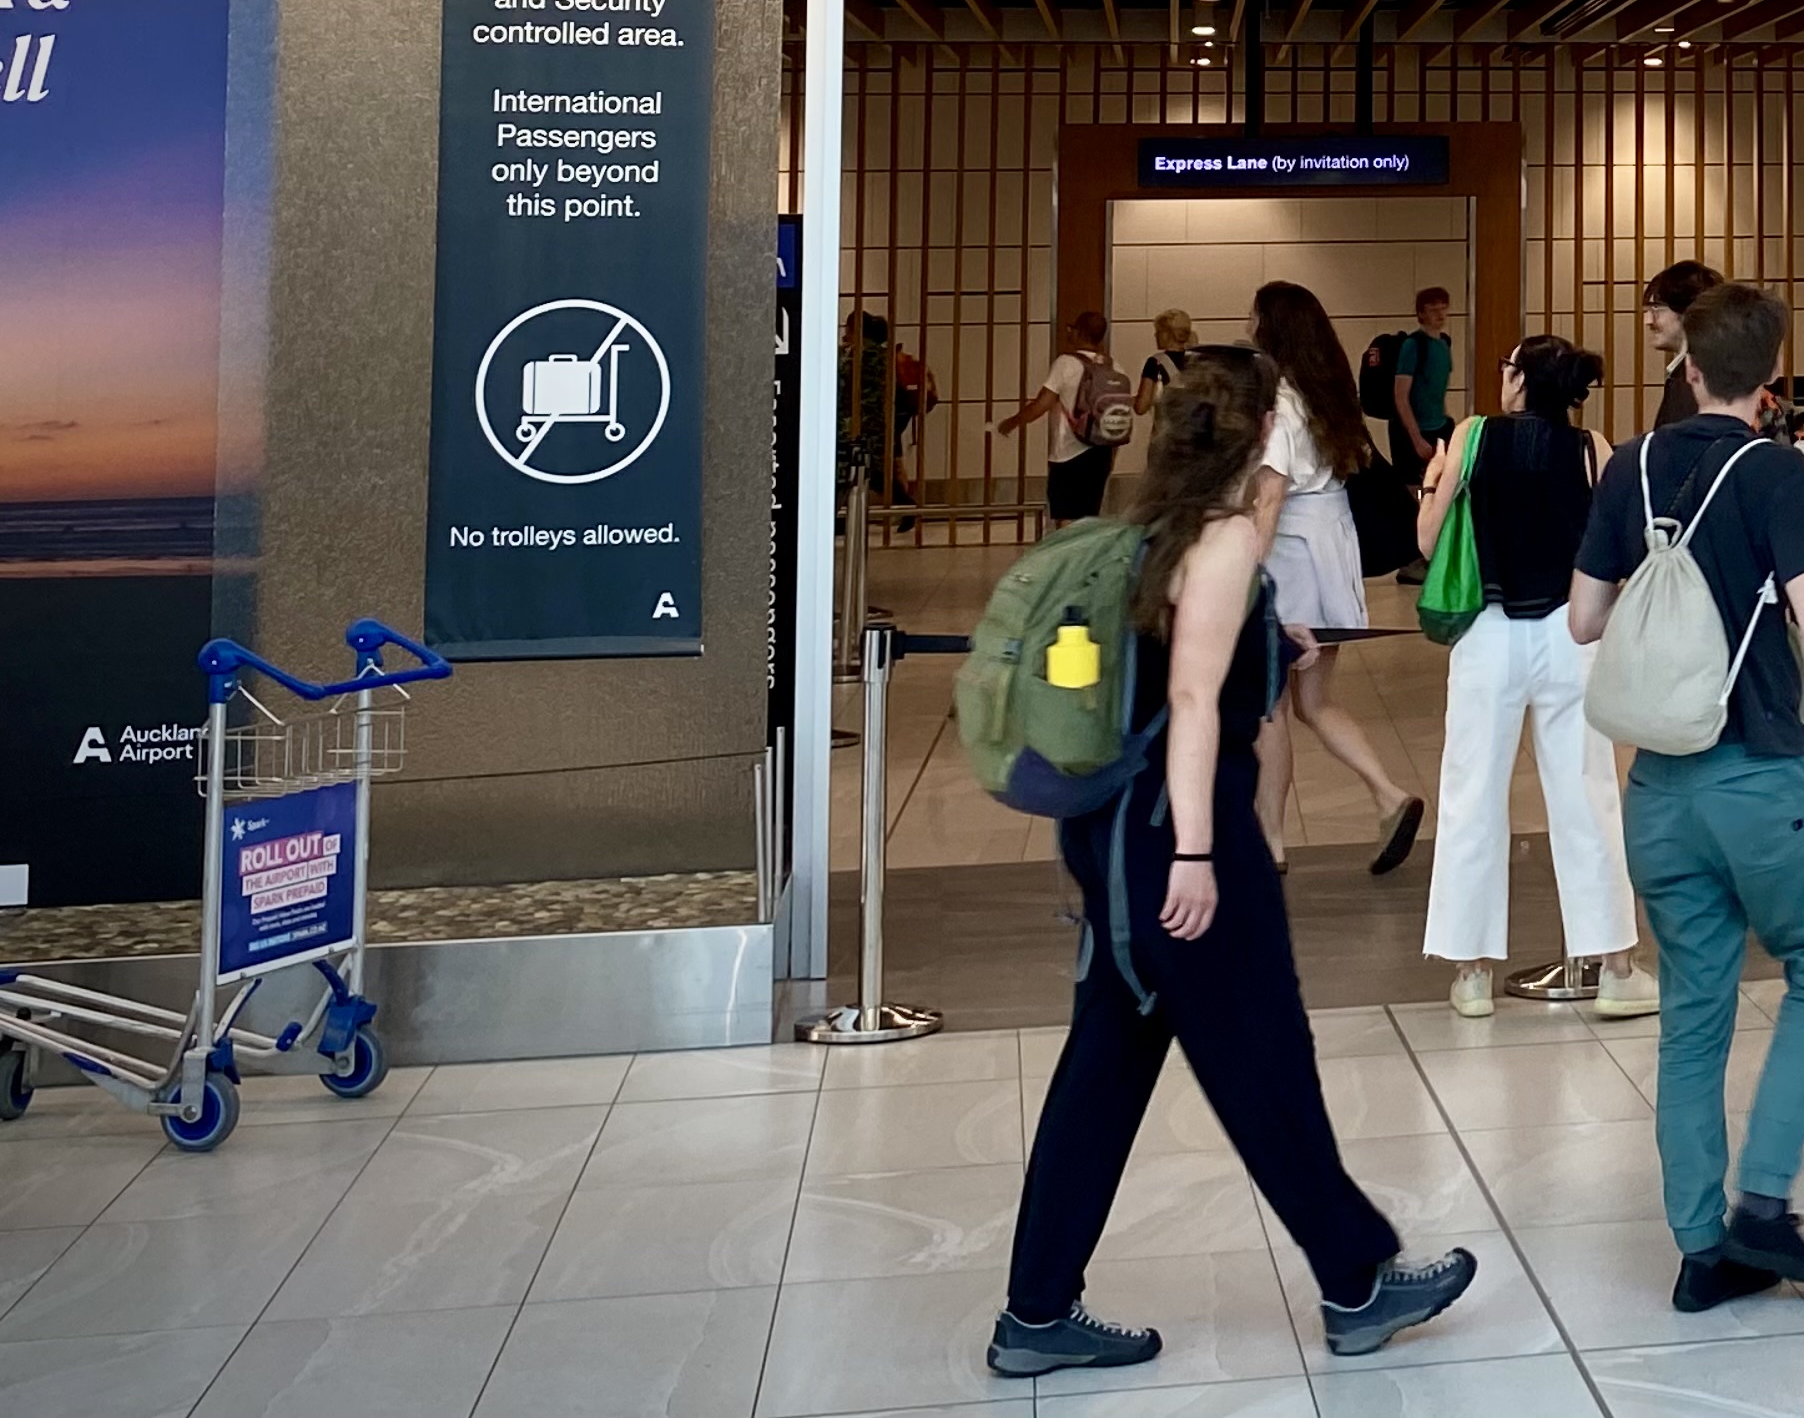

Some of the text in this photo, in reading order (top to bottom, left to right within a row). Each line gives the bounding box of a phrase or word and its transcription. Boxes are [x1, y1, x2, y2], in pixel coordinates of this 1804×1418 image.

[472, 19, 685, 48] controlled area.
[492, 88, 662, 115] International
[497, 123, 656, 153] Passengers
[491, 158, 660, 188] only beyond
[1154, 154, 1409, 173] Express Lane (by invitation only)
[506, 192, 641, 222] this point.
[450, 520, 680, 549] No trolleys allowed.
[119, 742, 194, 763] Airport
[241, 832, 338, 872] ROLL OUT OF
[309, 856, 333, 873] WITH
[253, 880, 325, 909] SPARK PREPAID
